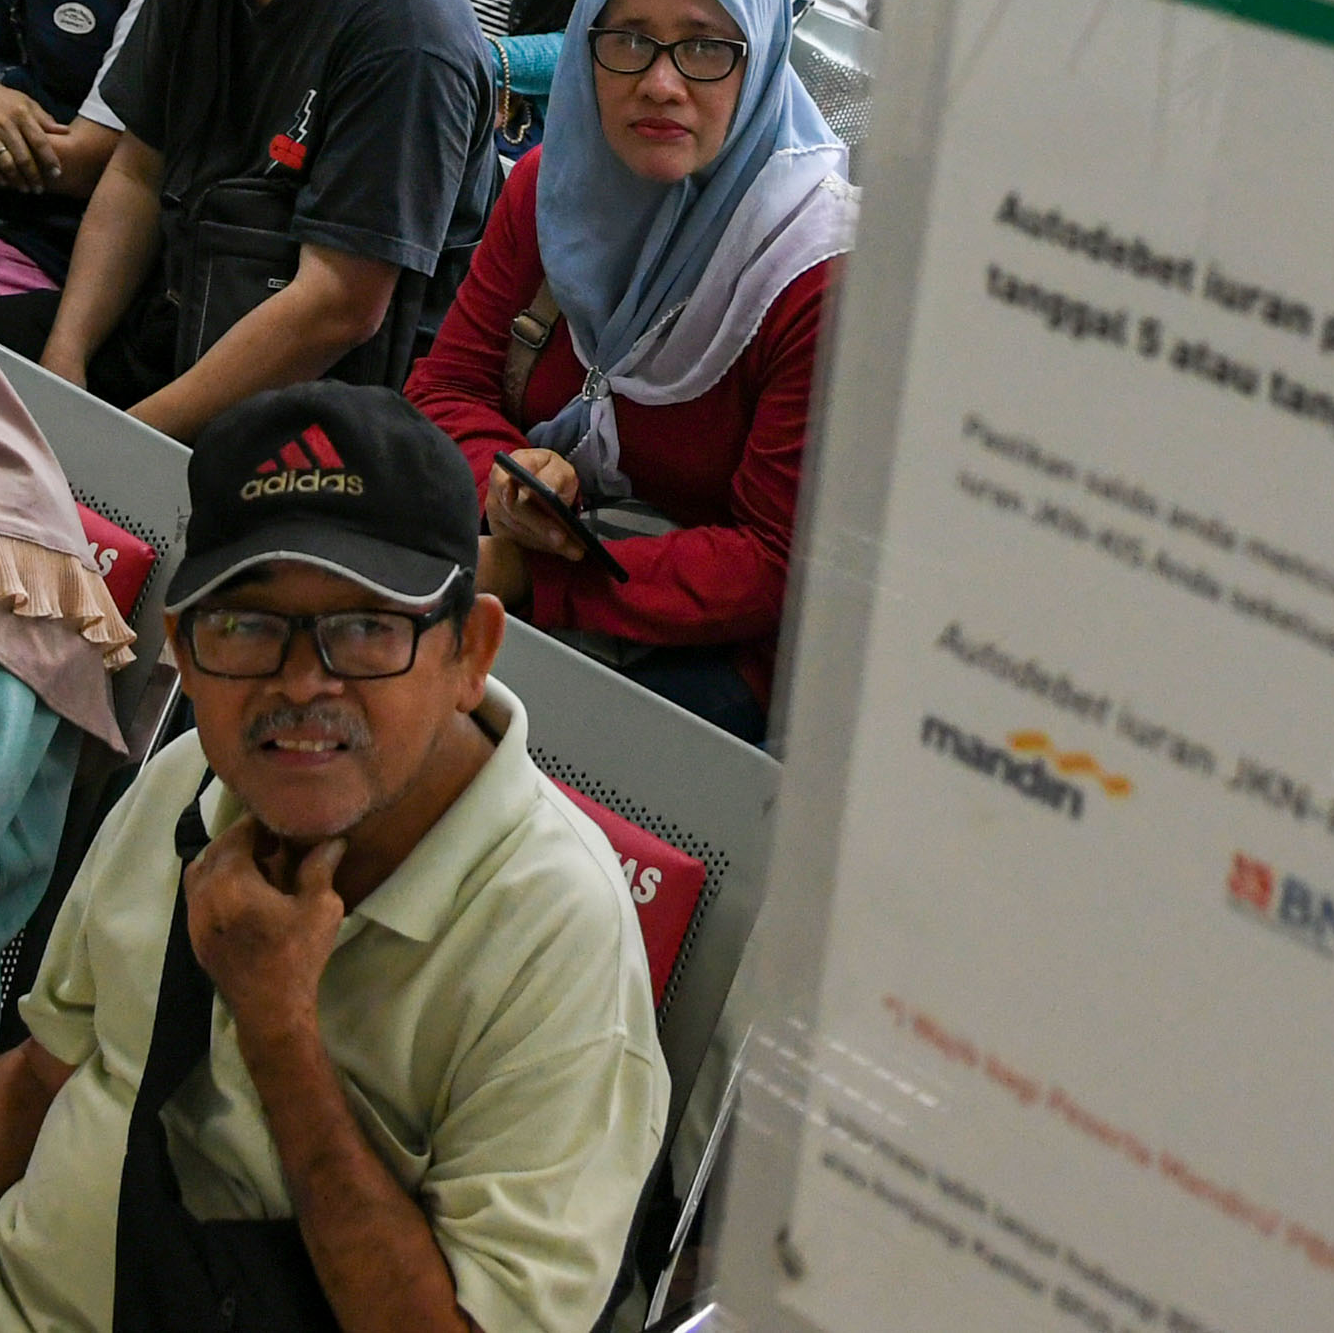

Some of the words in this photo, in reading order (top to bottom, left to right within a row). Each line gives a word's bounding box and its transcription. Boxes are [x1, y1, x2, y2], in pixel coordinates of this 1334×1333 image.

[995, 190, 1194, 295] Autodebet
[986, 261, 1127, 350] tanggal
[1169, 338, 1260, 400] atau
[240, 469, 363, 500] adidas
[935, 620, 1110, 725] Autodebet
